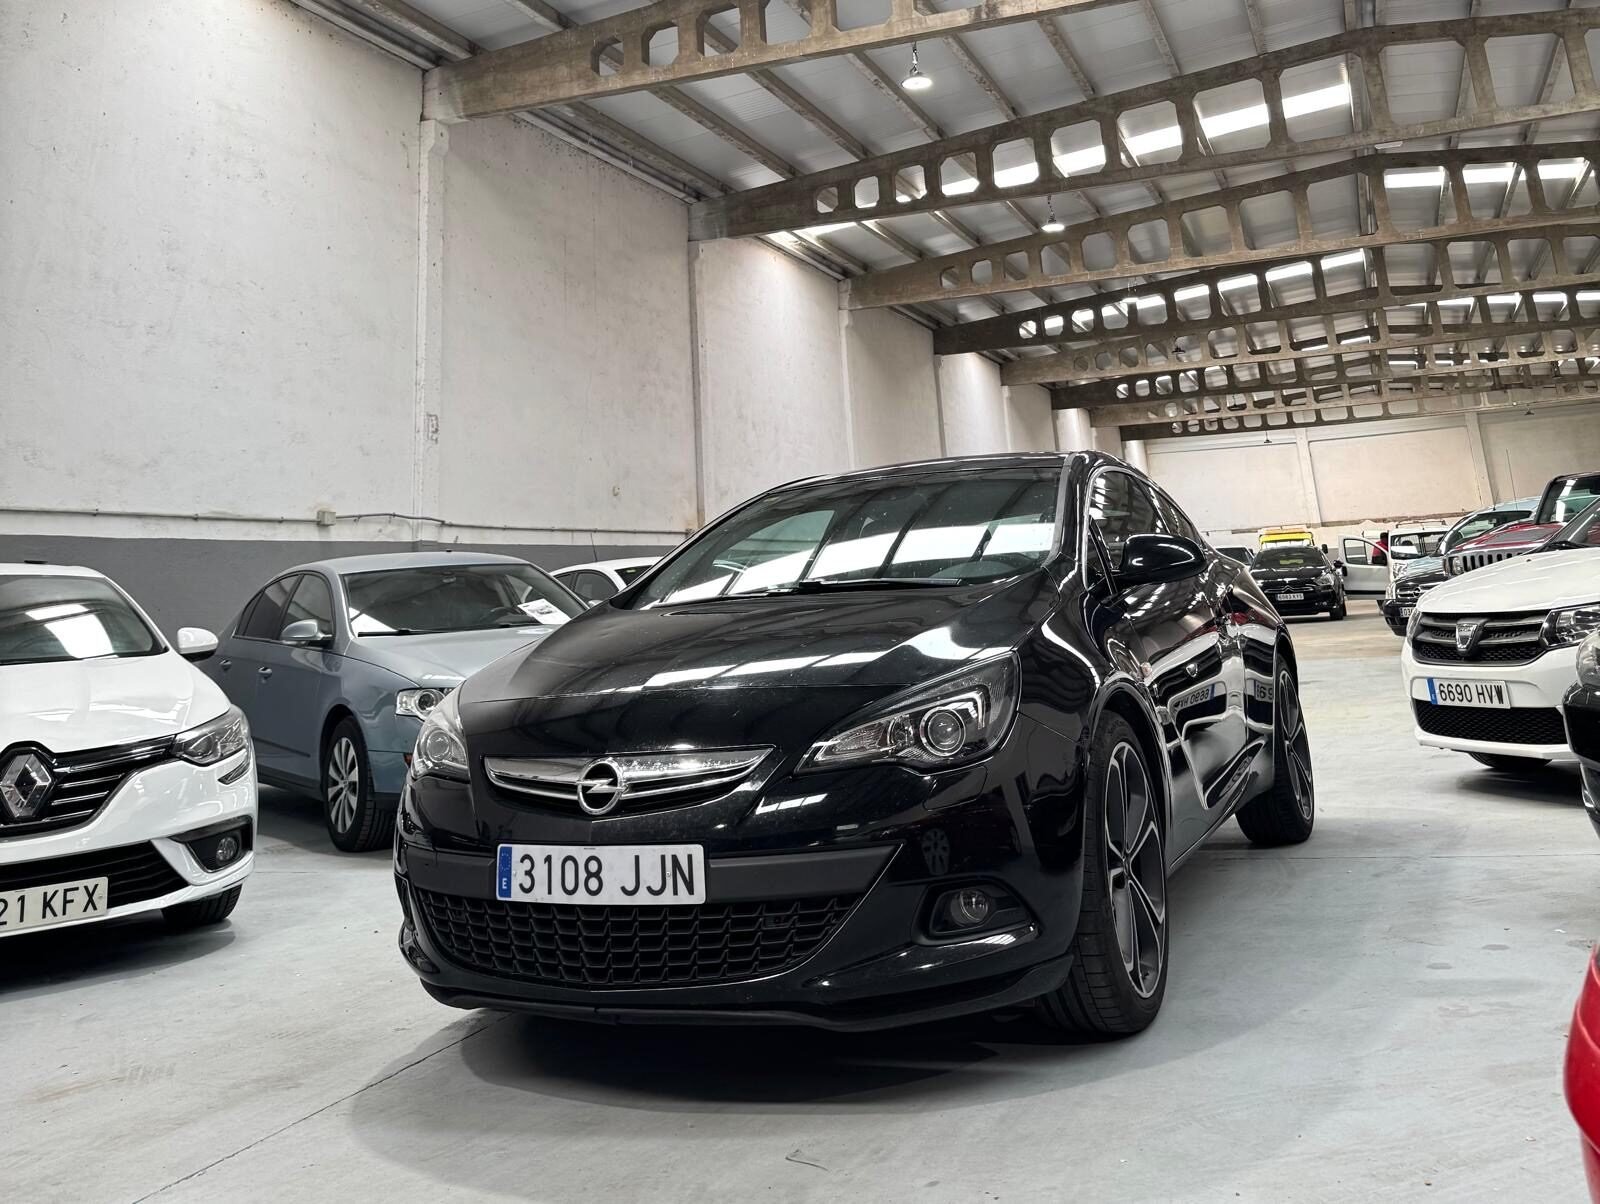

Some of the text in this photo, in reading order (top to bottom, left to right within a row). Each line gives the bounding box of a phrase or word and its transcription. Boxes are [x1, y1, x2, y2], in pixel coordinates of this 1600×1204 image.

[1438, 683, 1504, 704] 6690 HVW
[502, 853, 695, 897] E 3108 JJN
[41, 883, 99, 919] KFX
